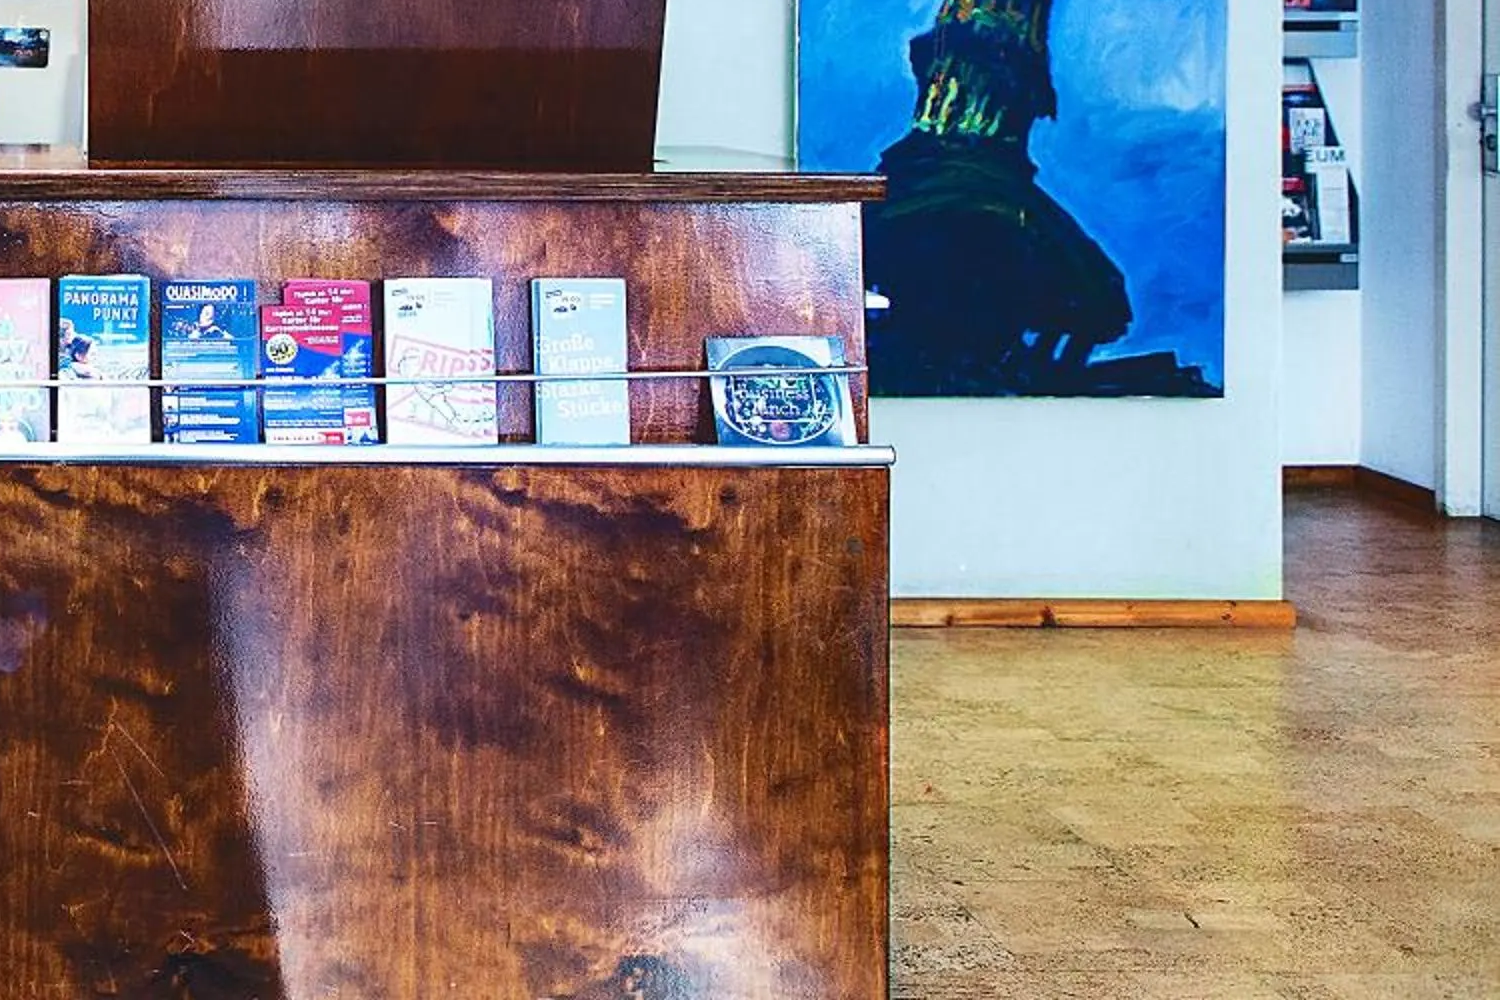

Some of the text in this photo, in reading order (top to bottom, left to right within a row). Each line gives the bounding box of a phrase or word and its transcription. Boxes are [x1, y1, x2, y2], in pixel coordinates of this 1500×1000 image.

[63, 291, 139, 307] PANORAMA
[165, 285, 238, 301] QUASIMODO
[93, 307, 139, 321] PUNKT
